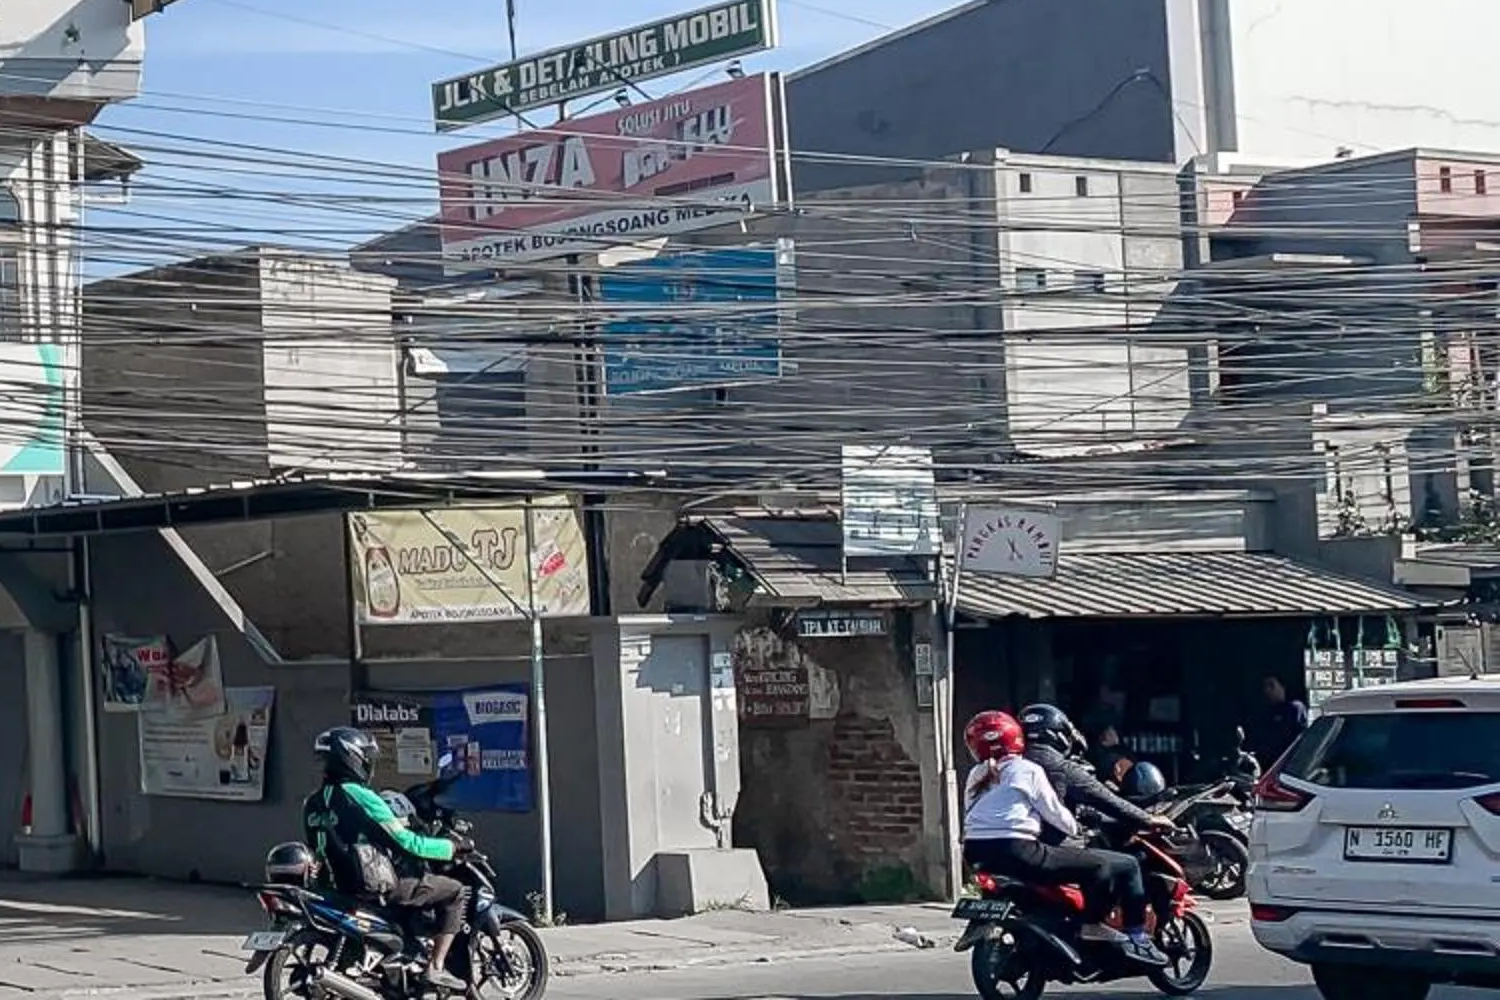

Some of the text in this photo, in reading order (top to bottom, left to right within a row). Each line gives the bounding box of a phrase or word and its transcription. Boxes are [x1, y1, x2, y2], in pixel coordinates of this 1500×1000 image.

[492, 69, 514, 96] &
[663, 2, 758, 52] MOBIL
[617, 100, 691, 137] SOLUSI JITU
[399, 526, 518, 577] MADU TJ
[966, 515, 1054, 566] PANGKAS RAMBUT
[1349, 831, 1360, 847] N
[1373, 831, 1414, 848] 1560
